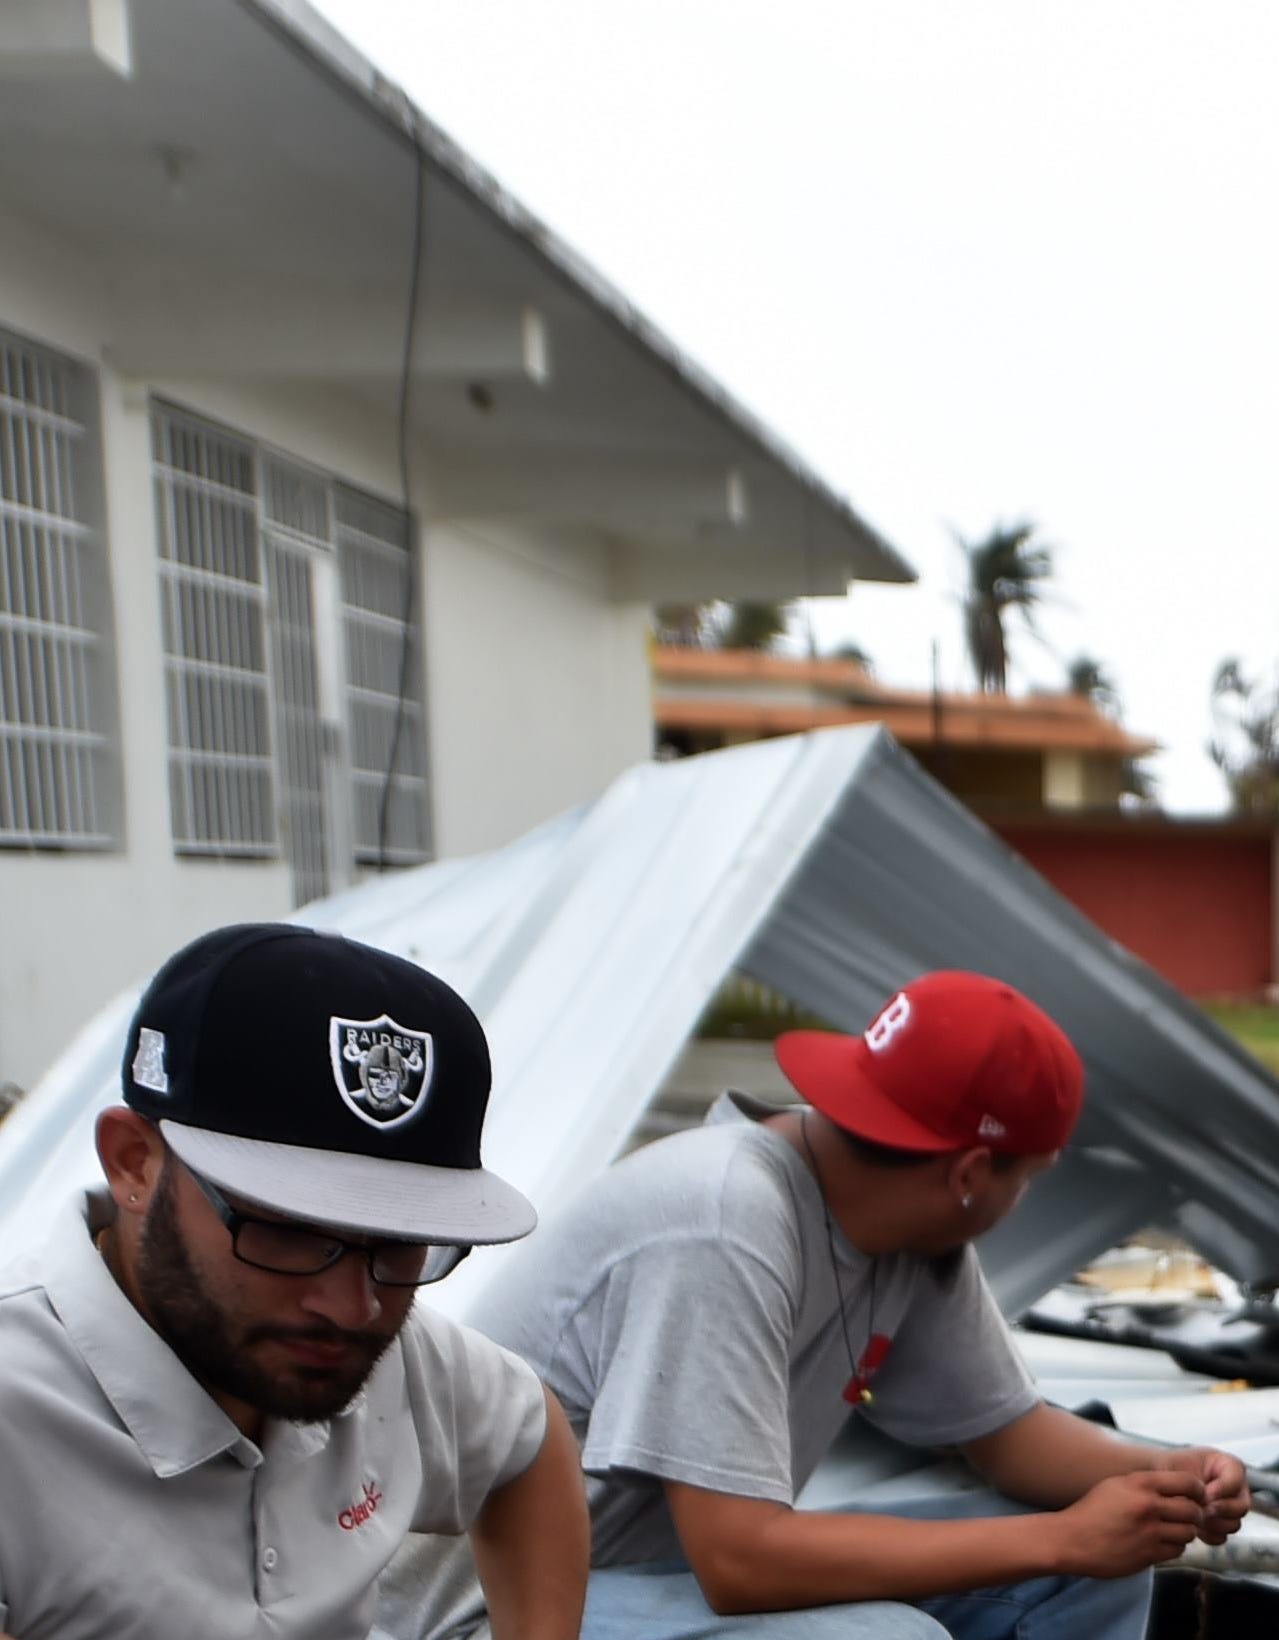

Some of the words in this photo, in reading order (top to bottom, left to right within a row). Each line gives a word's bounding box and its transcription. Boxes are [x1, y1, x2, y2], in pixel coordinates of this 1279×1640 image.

[346, 1028, 421, 1052] RAIDERS
[864, 992, 911, 1052] B
[338, 1491, 379, 1530] Claro
